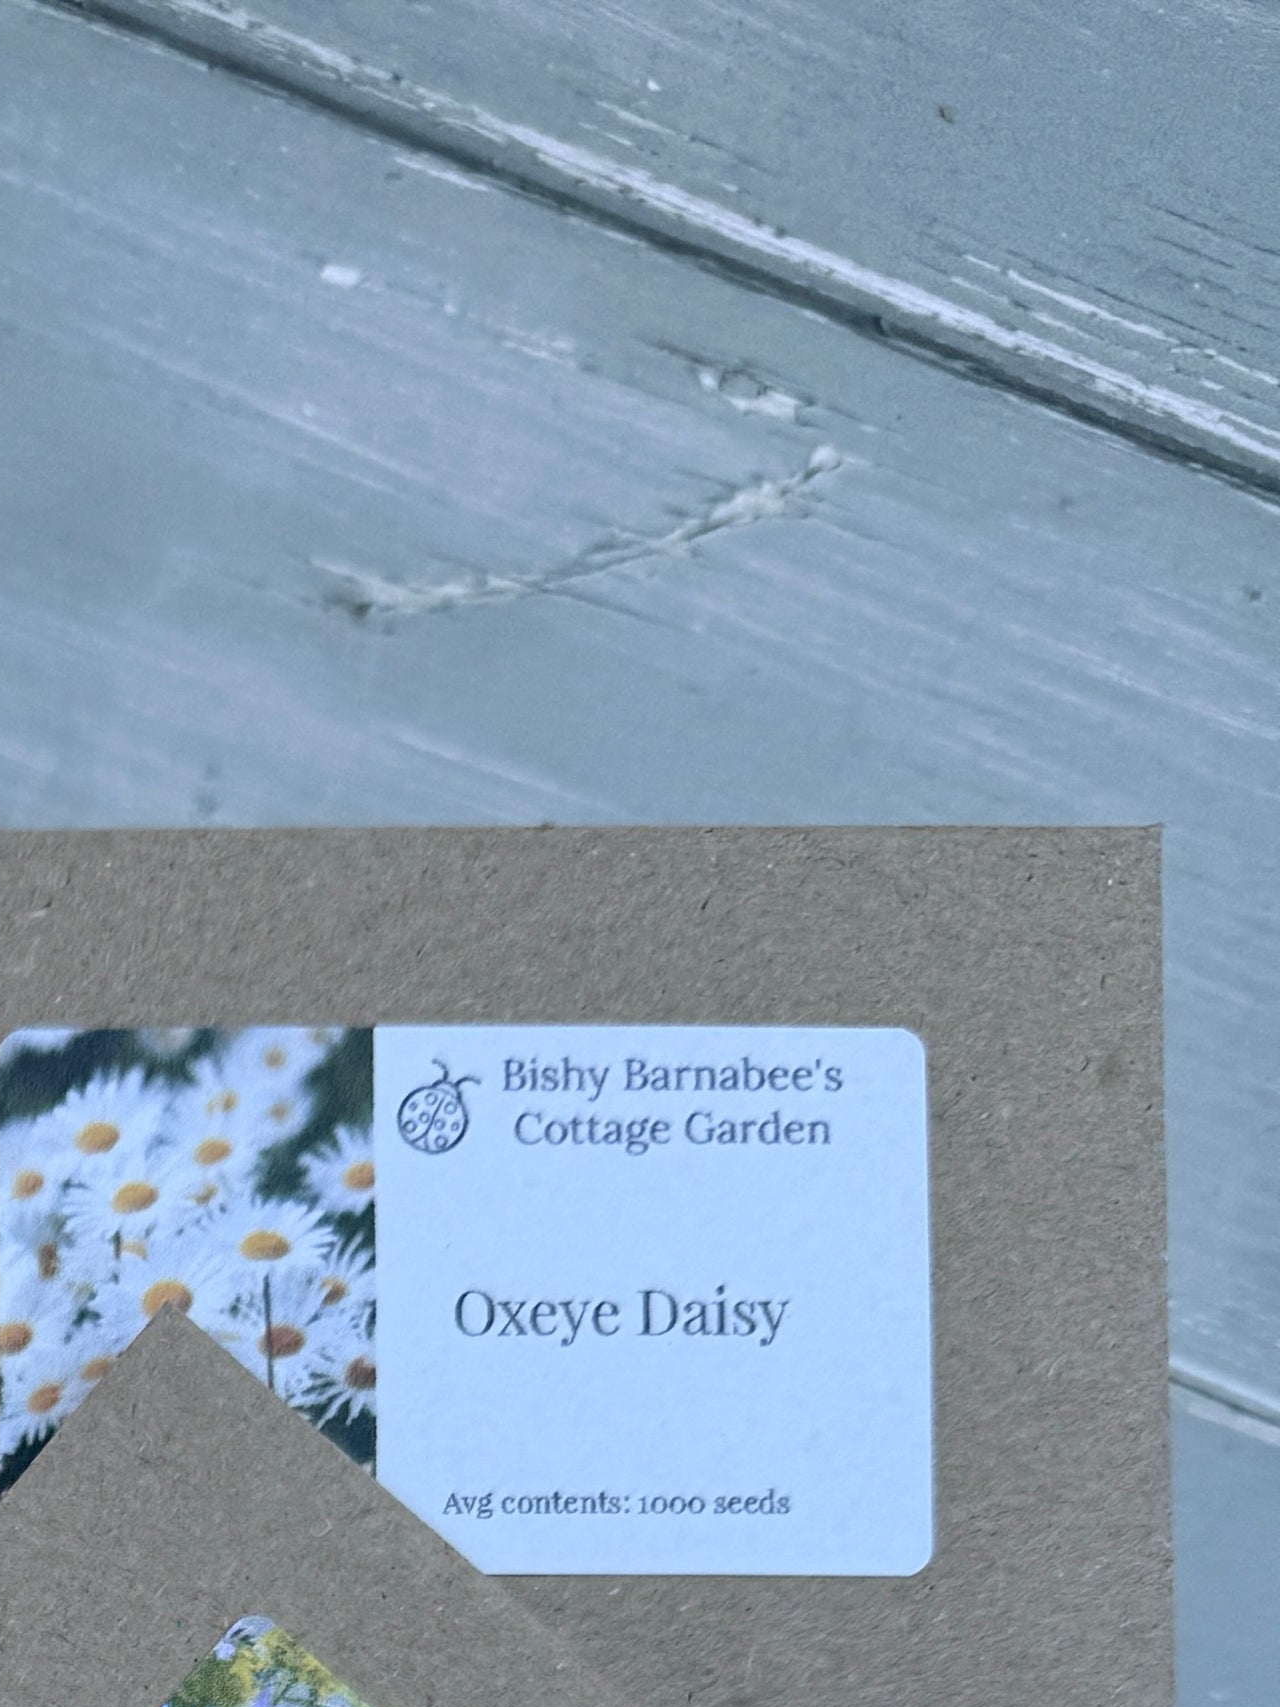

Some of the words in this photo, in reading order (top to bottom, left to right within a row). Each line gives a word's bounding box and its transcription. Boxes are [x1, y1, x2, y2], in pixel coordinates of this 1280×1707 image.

[502, 1058, 608, 1101] Bishy
[623, 1058, 844, 1092] Barnabee's
[513, 1112, 671, 1156] Cottage
[685, 1112, 830, 1145] Garden
[455, 1290, 621, 1346] Oxeye
[637, 1284, 789, 1346] Daisy
[443, 1492, 492, 1518] Avg
[502, 1490, 630, 1515] contents:
[638, 1495, 706, 1515] 1000
[714, 1490, 790, 1515] seeds
